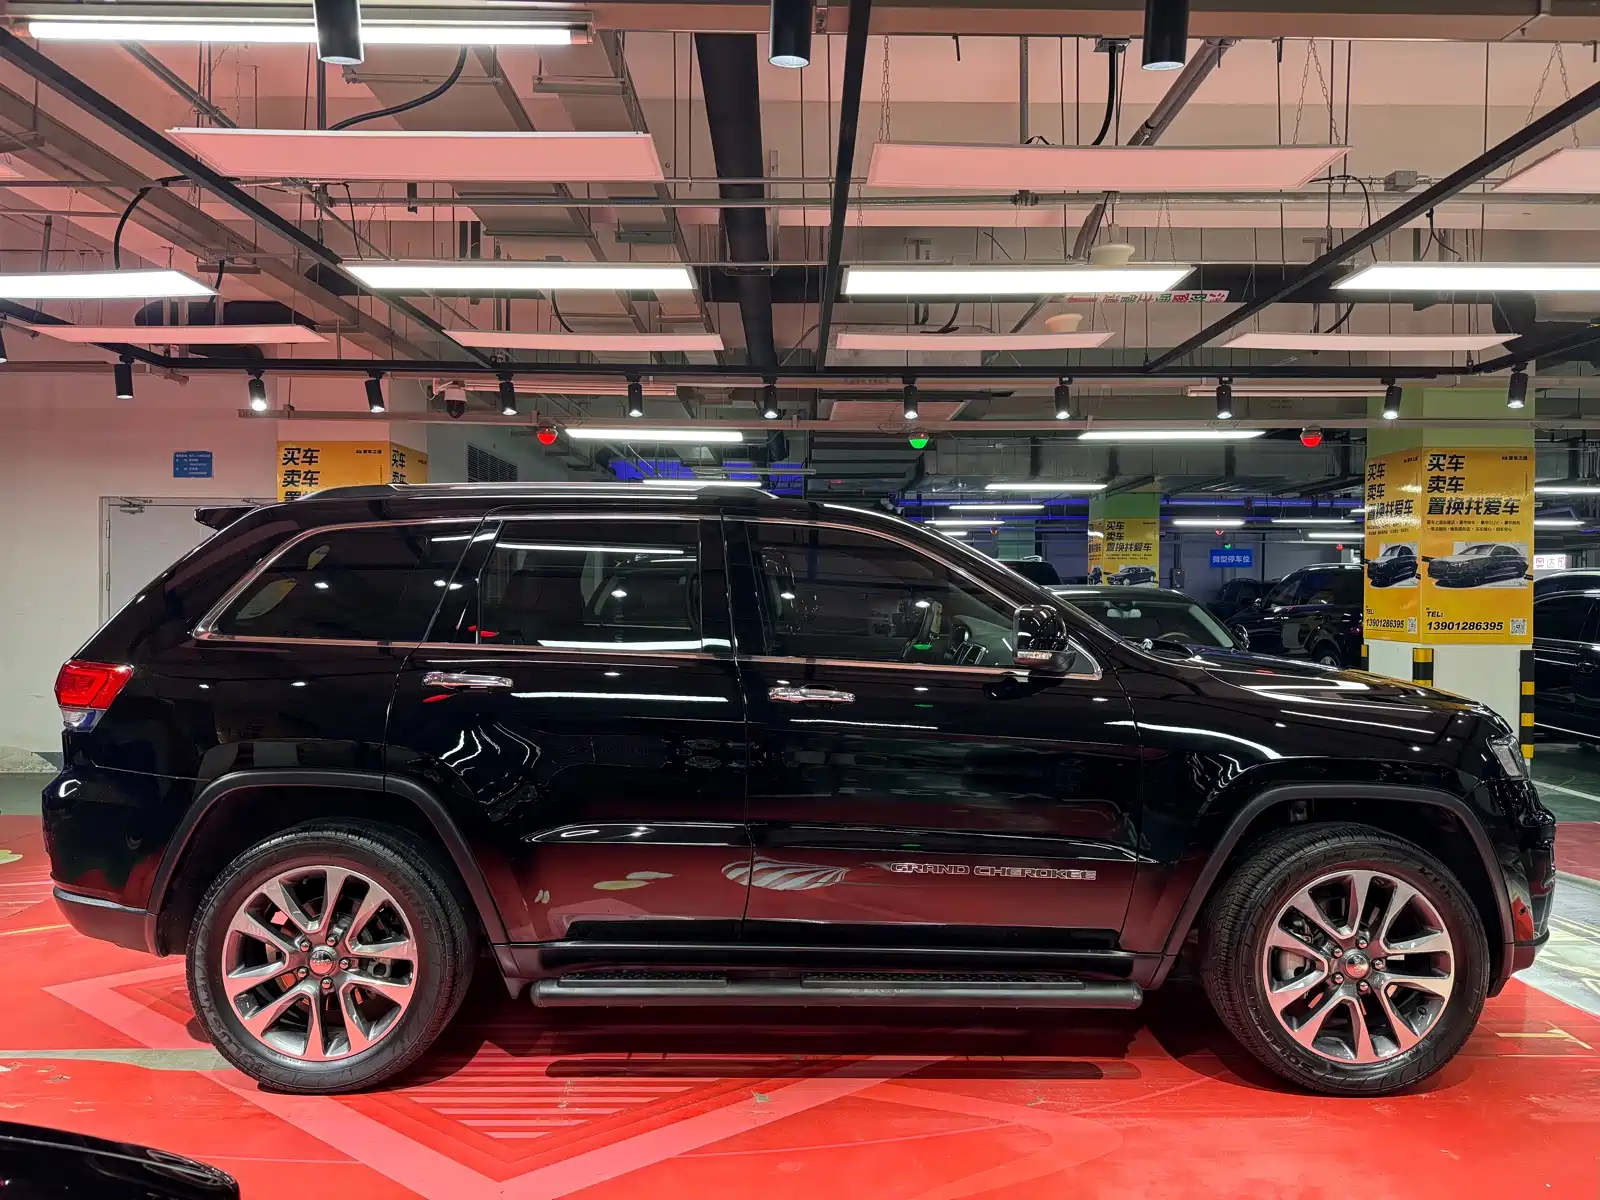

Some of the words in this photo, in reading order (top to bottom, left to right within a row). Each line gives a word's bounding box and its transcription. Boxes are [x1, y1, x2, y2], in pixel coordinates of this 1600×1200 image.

[282, 448, 320, 465] 买车
[391, 449, 406, 470] 买车
[1427, 453, 1466, 472] 买车
[282, 469, 320, 487] 卖车
[1367, 462, 1386, 481] 买车
[1367, 482, 1386, 501] 卖车
[1427, 475, 1466, 493] 卖车
[1367, 499, 1414, 521] 置换找爱车
[1427, 496, 1521, 515] 置换找爱车
[1106, 520, 1125, 531] 买车
[1106, 542, 1152, 552] 置换找爱车
[1366, 618, 1405, 629] 13901286395
[1426, 621, 1504, 631] 13901286395
[890, 862, 970, 875] GRAND
[974, 865, 1097, 880] CHEROKEE
